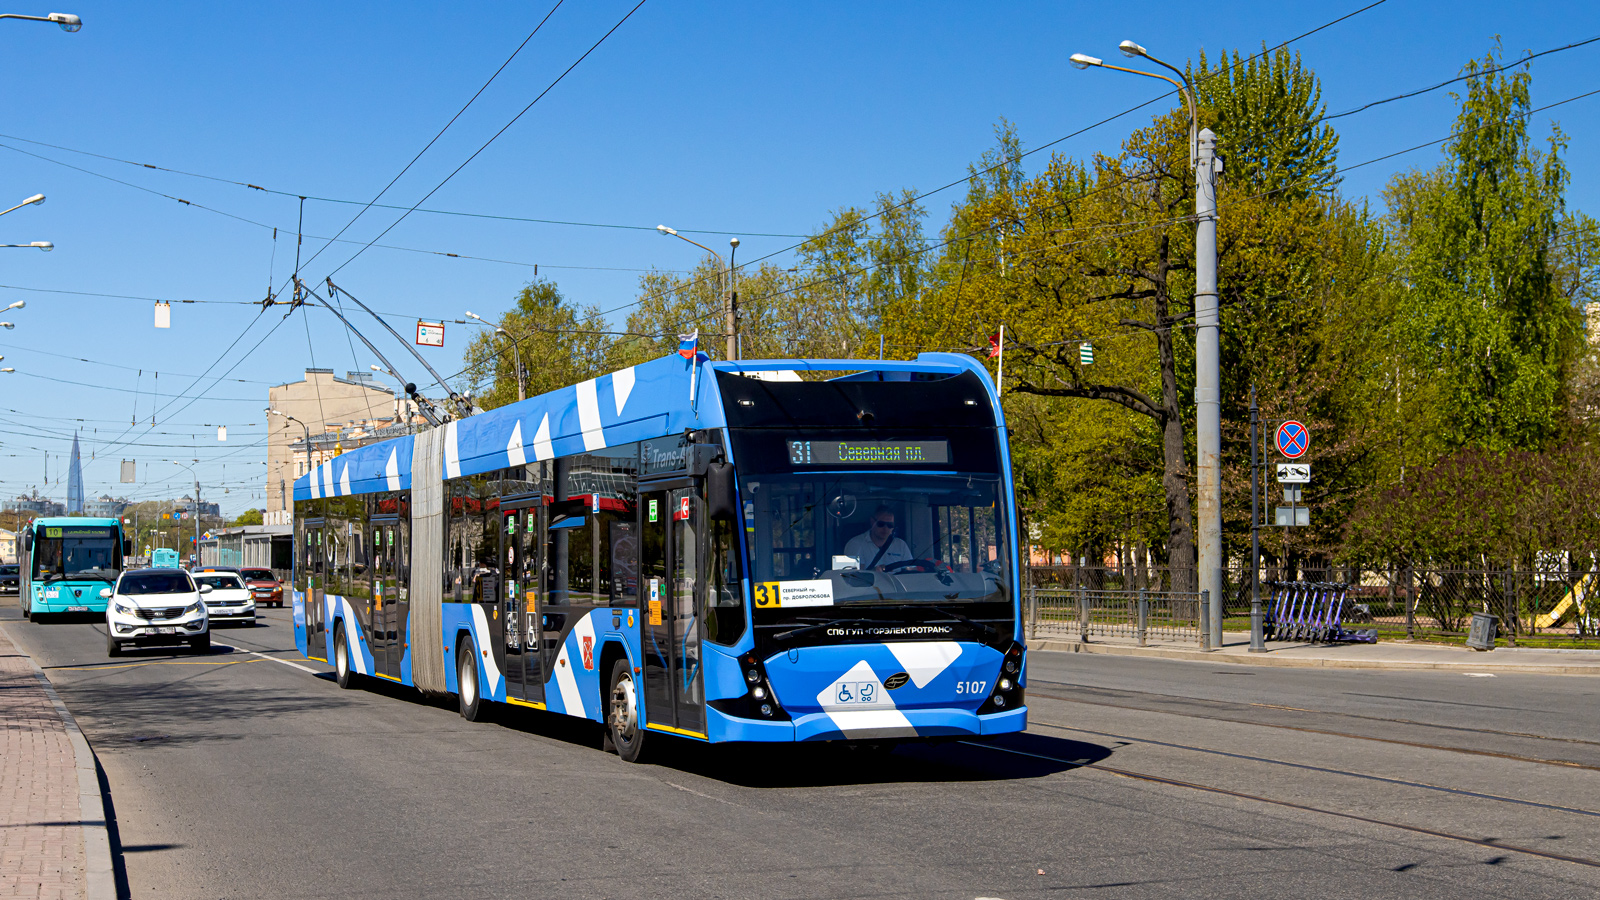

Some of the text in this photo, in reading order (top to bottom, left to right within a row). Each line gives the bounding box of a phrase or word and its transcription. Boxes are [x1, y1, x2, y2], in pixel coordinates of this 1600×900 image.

[792, 441, 926, 464] 31 Северная пл.
[48, 528, 59, 536] 10
[756, 584, 780, 606] 31
[865, 626, 953, 635] «ГОРЭЛЕКТРОТРАНС»
[955, 681, 987, 694] 5107
